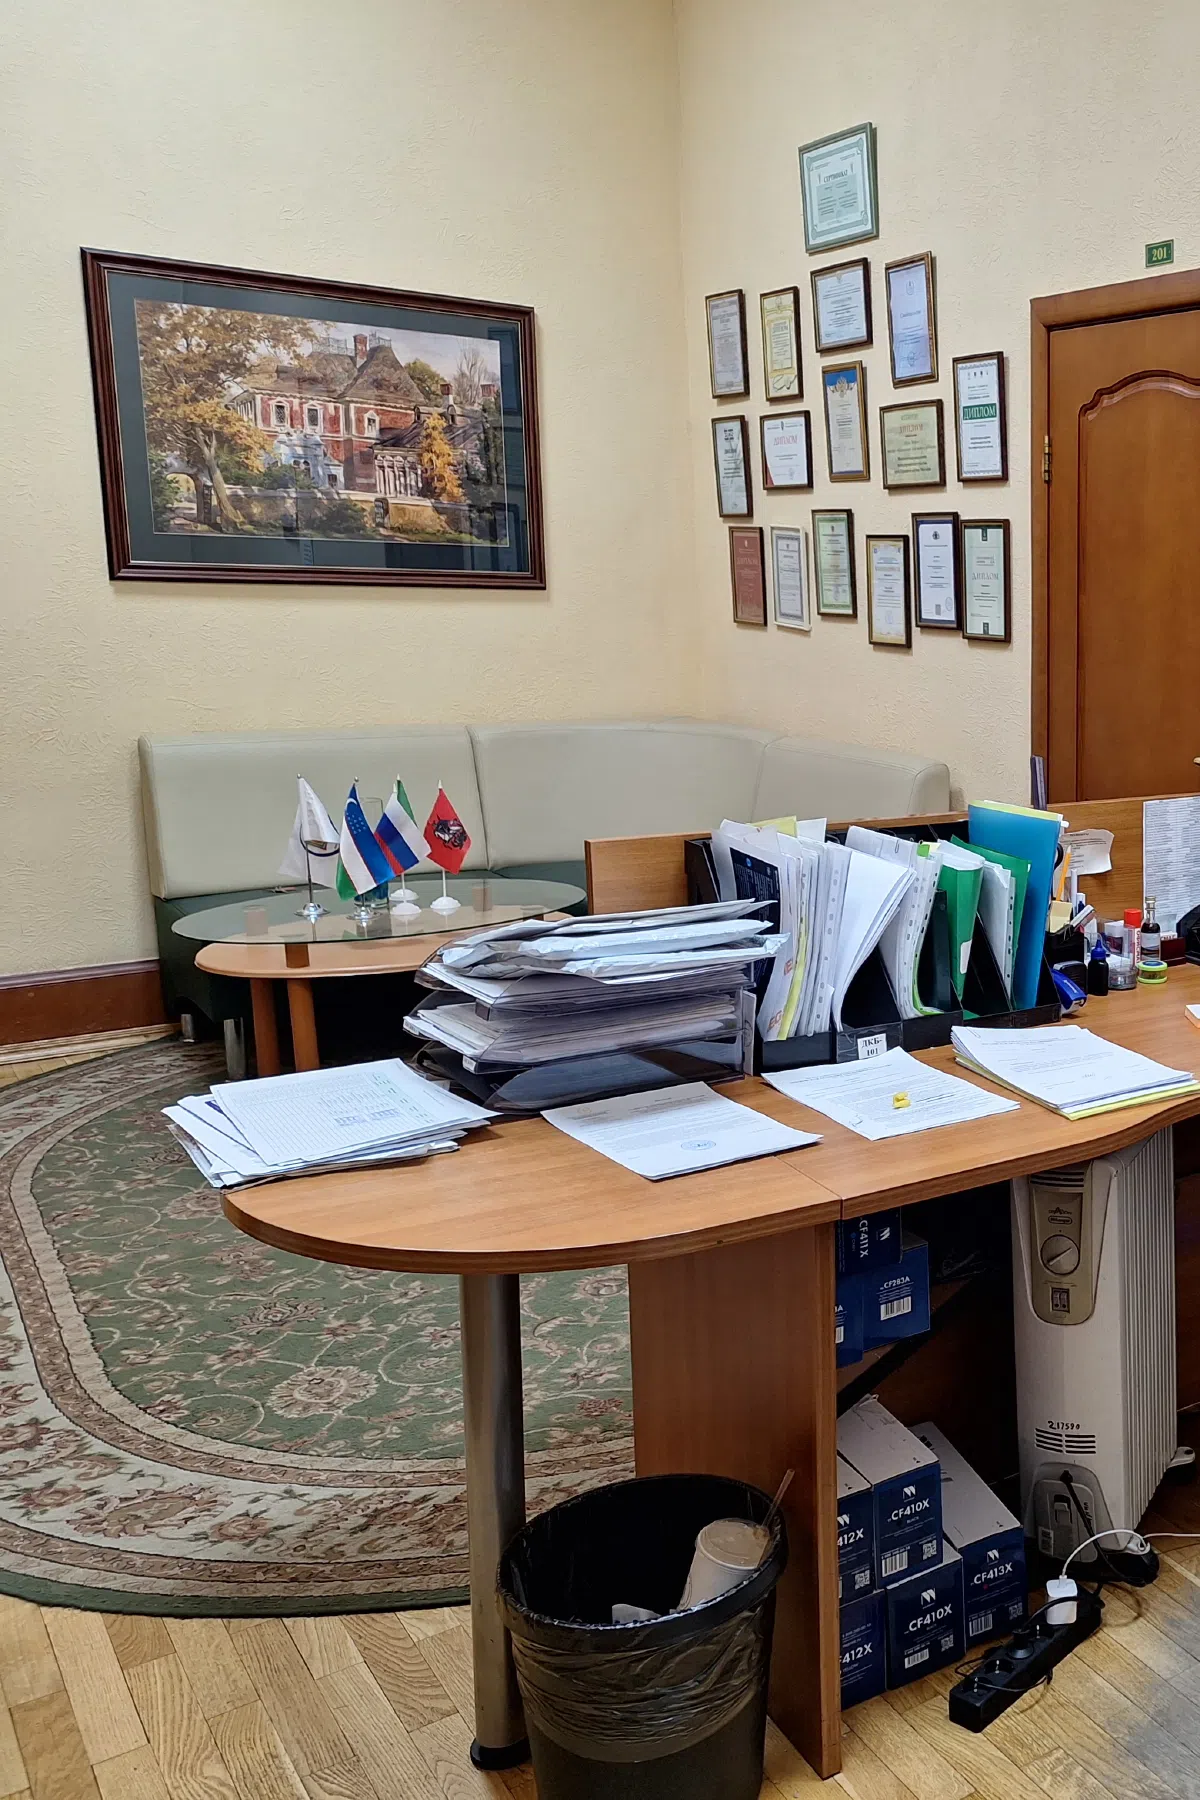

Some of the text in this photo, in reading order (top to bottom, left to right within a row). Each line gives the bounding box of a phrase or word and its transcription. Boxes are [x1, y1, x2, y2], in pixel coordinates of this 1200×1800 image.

[1152, 247, 1167, 260] 201
[964, 405, 996, 420] ДИПЛОМ
[862, 1036, 882, 1048] ДКБ-
[867, 1048, 878, 1056] 101
[1047, 1420, 1081, 1430] 217590
